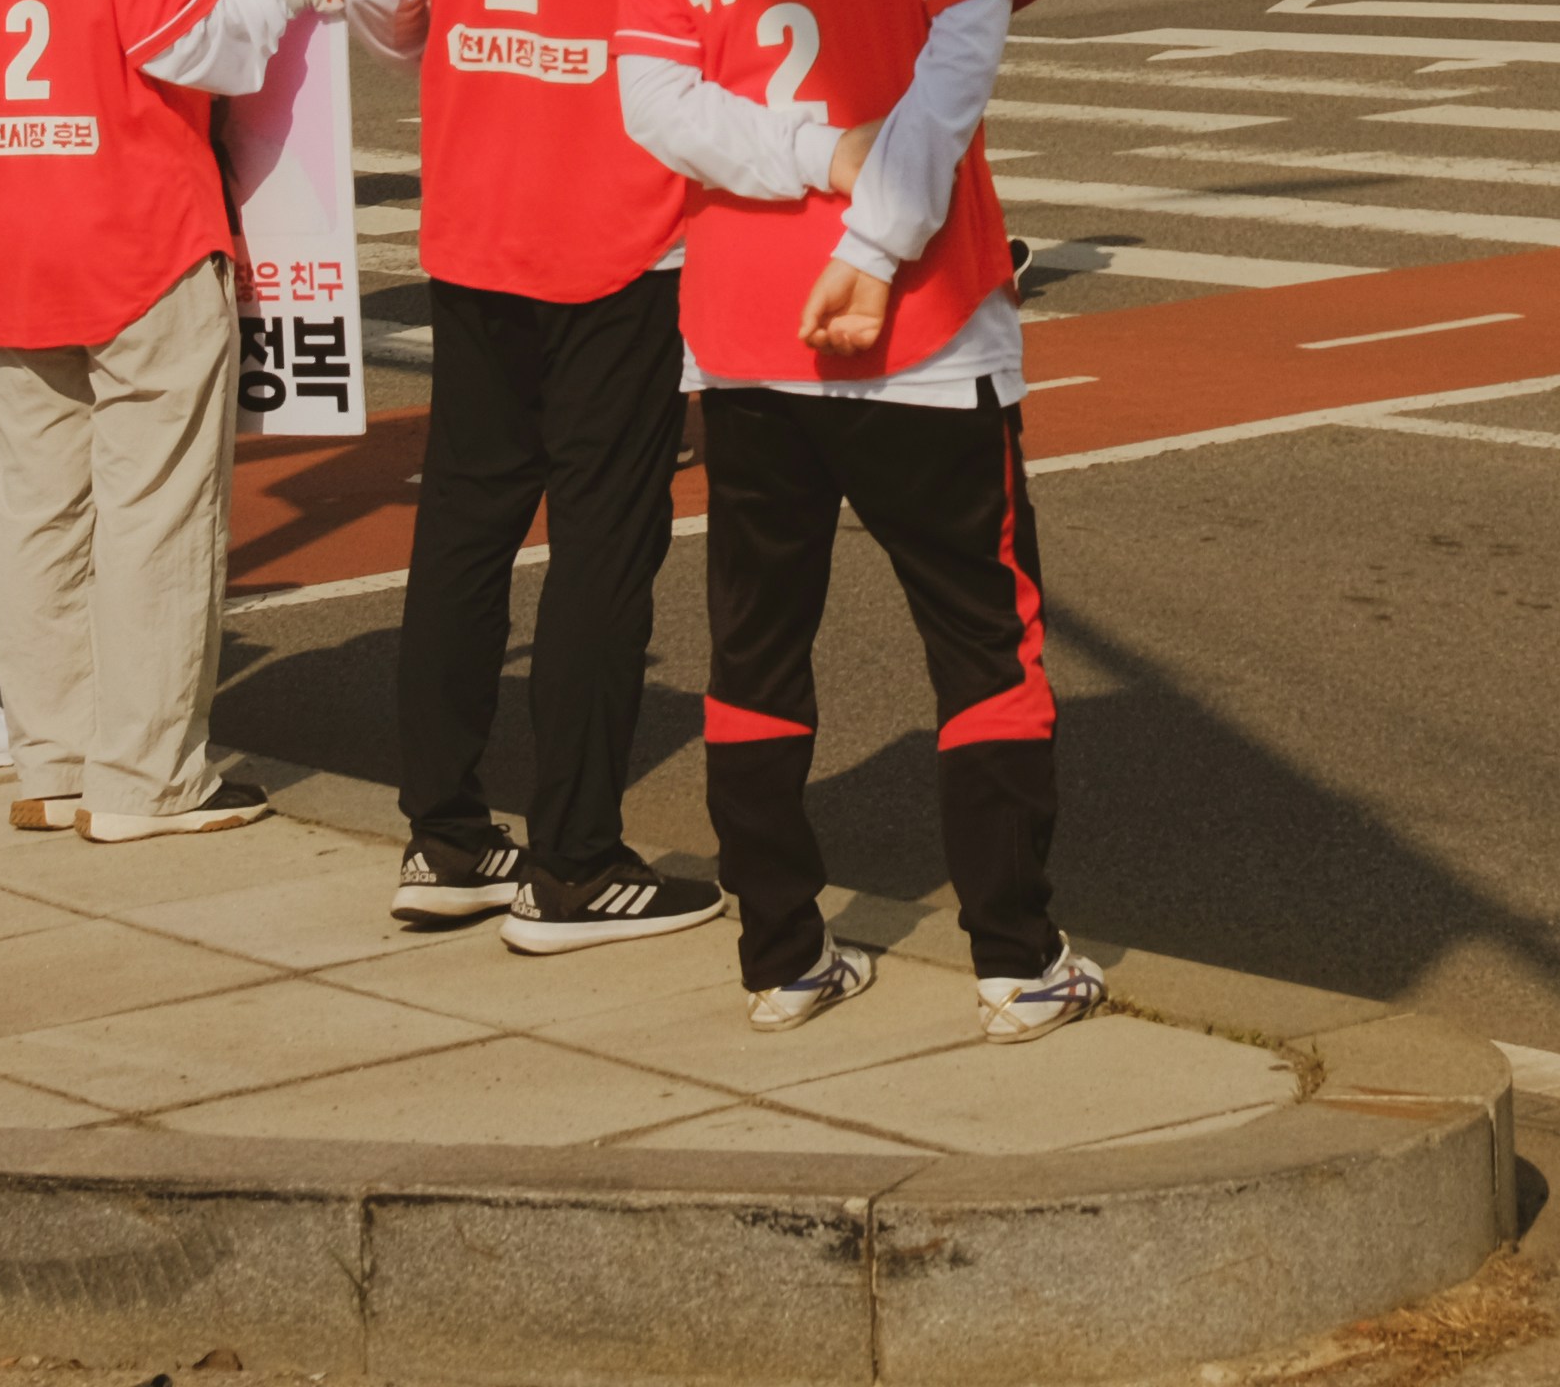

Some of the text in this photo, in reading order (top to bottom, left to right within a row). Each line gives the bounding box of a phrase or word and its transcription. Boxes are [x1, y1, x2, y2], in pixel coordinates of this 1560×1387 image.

[540, 43, 589, 74] 후보
[755, 1, 829, 125] 2
[53, 122, 94, 149] 후보
[290, 261, 344, 303] 친구
